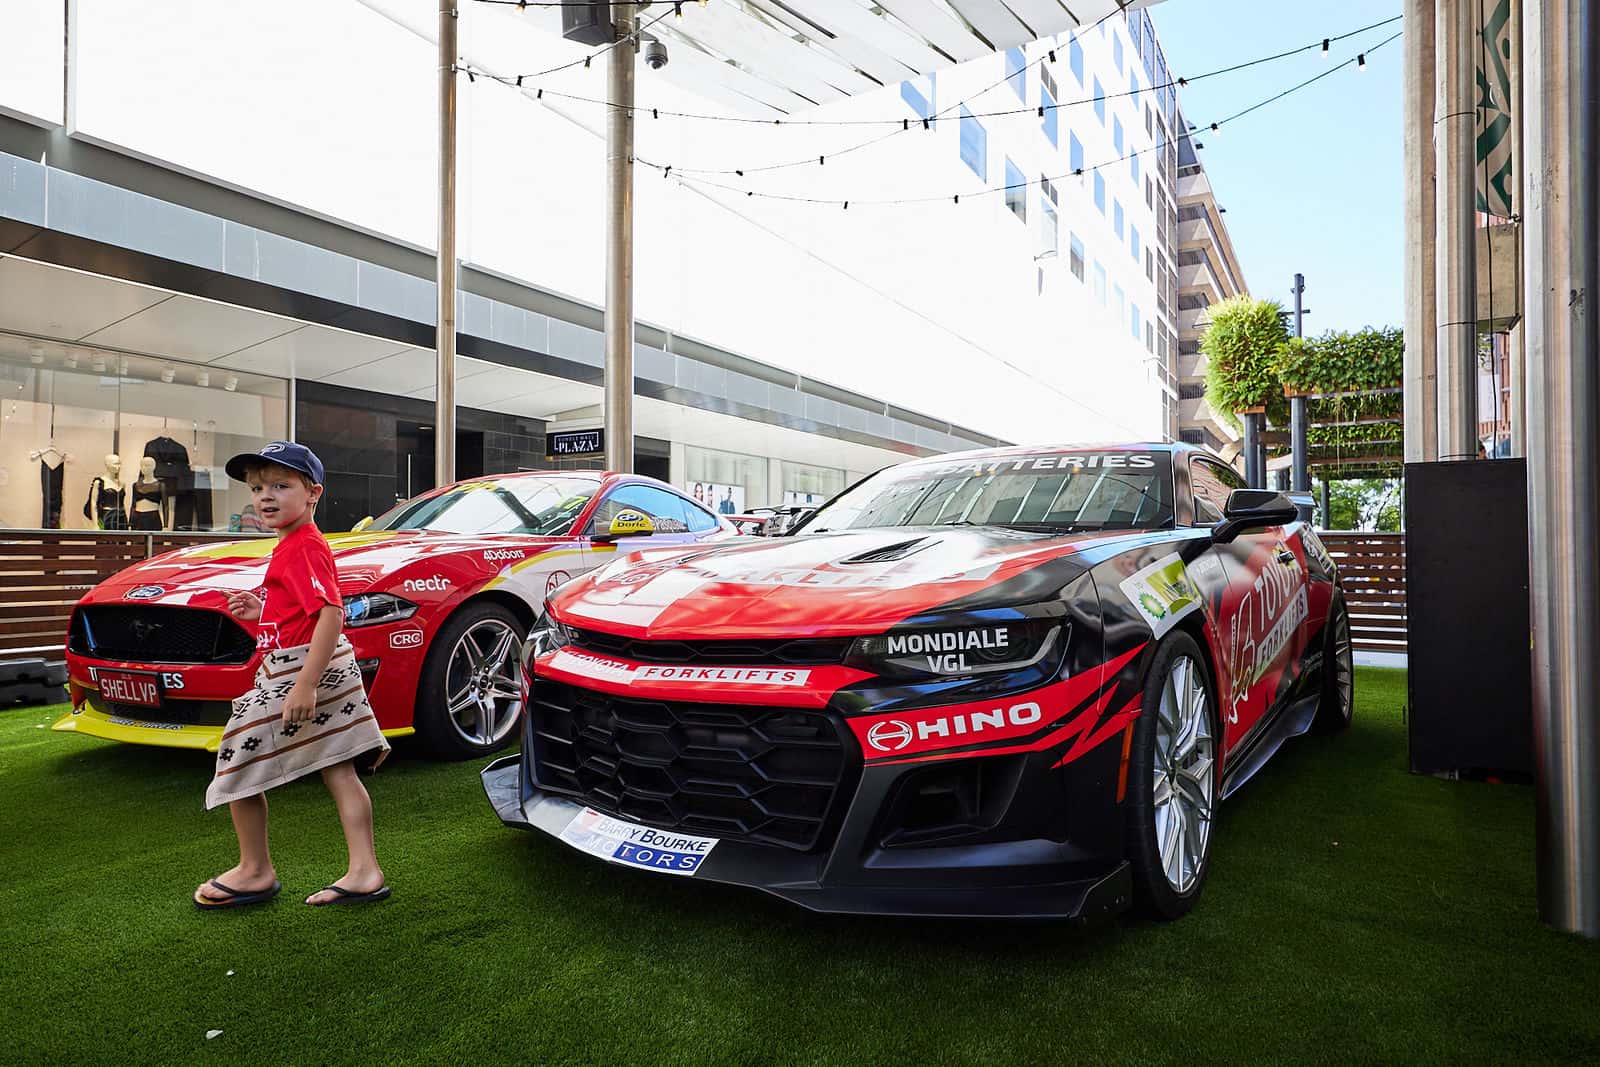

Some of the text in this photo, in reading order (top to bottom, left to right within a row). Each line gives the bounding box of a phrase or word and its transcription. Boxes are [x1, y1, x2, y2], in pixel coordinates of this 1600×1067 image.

[559, 440, 594, 453] PLAZA
[937, 455, 1156, 475] BATTERIES
[403, 574, 451, 592] nectr
[392, 632, 421, 645] CRC
[887, 628, 1009, 655] MONDIALE
[926, 653, 972, 673] VGL
[644, 667, 797, 682] FORKLIFTS
[916, 701, 1042, 741] HINO
[640, 829, 711, 852] BOURKE
